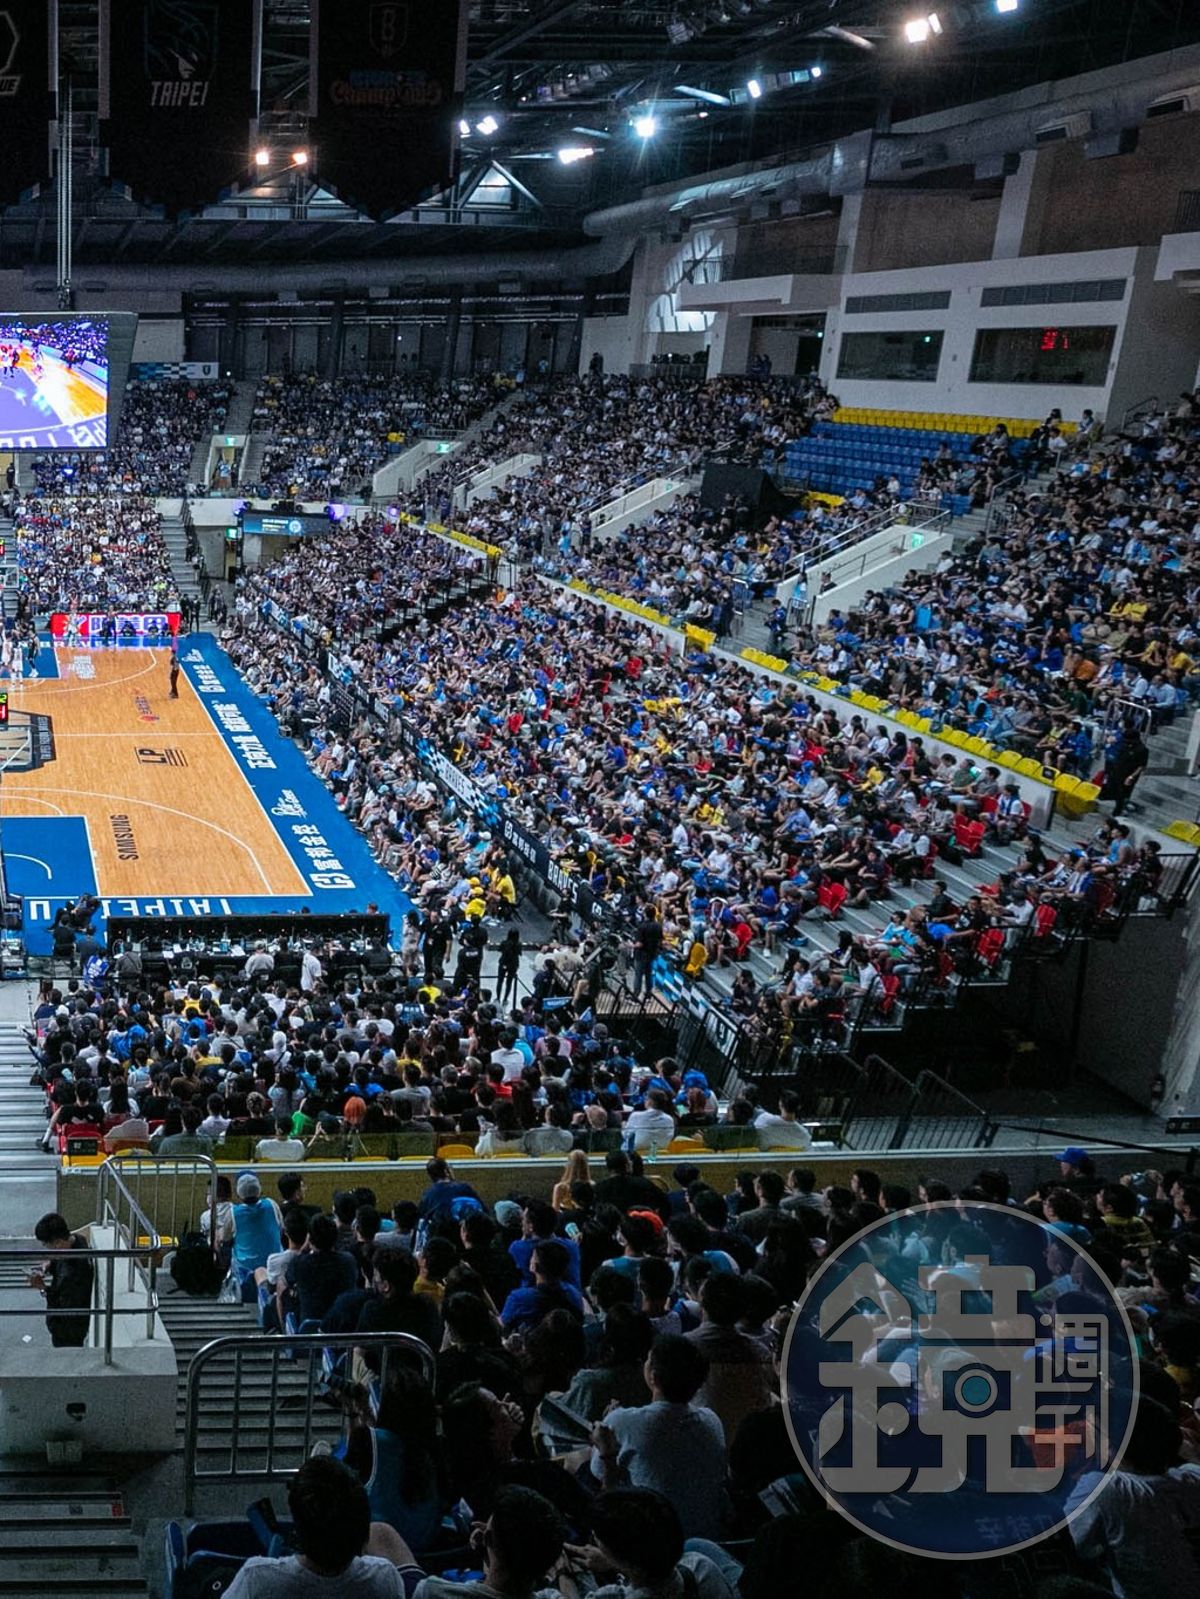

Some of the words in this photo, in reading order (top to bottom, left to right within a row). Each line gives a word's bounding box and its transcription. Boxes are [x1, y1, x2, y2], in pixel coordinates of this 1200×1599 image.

[150, 81, 209, 107] TAIPEI
[231, 735, 277, 769] 正向力量
[110, 814, 139, 861] SAMSUNG
[291, 824, 344, 871] 富邦金控
